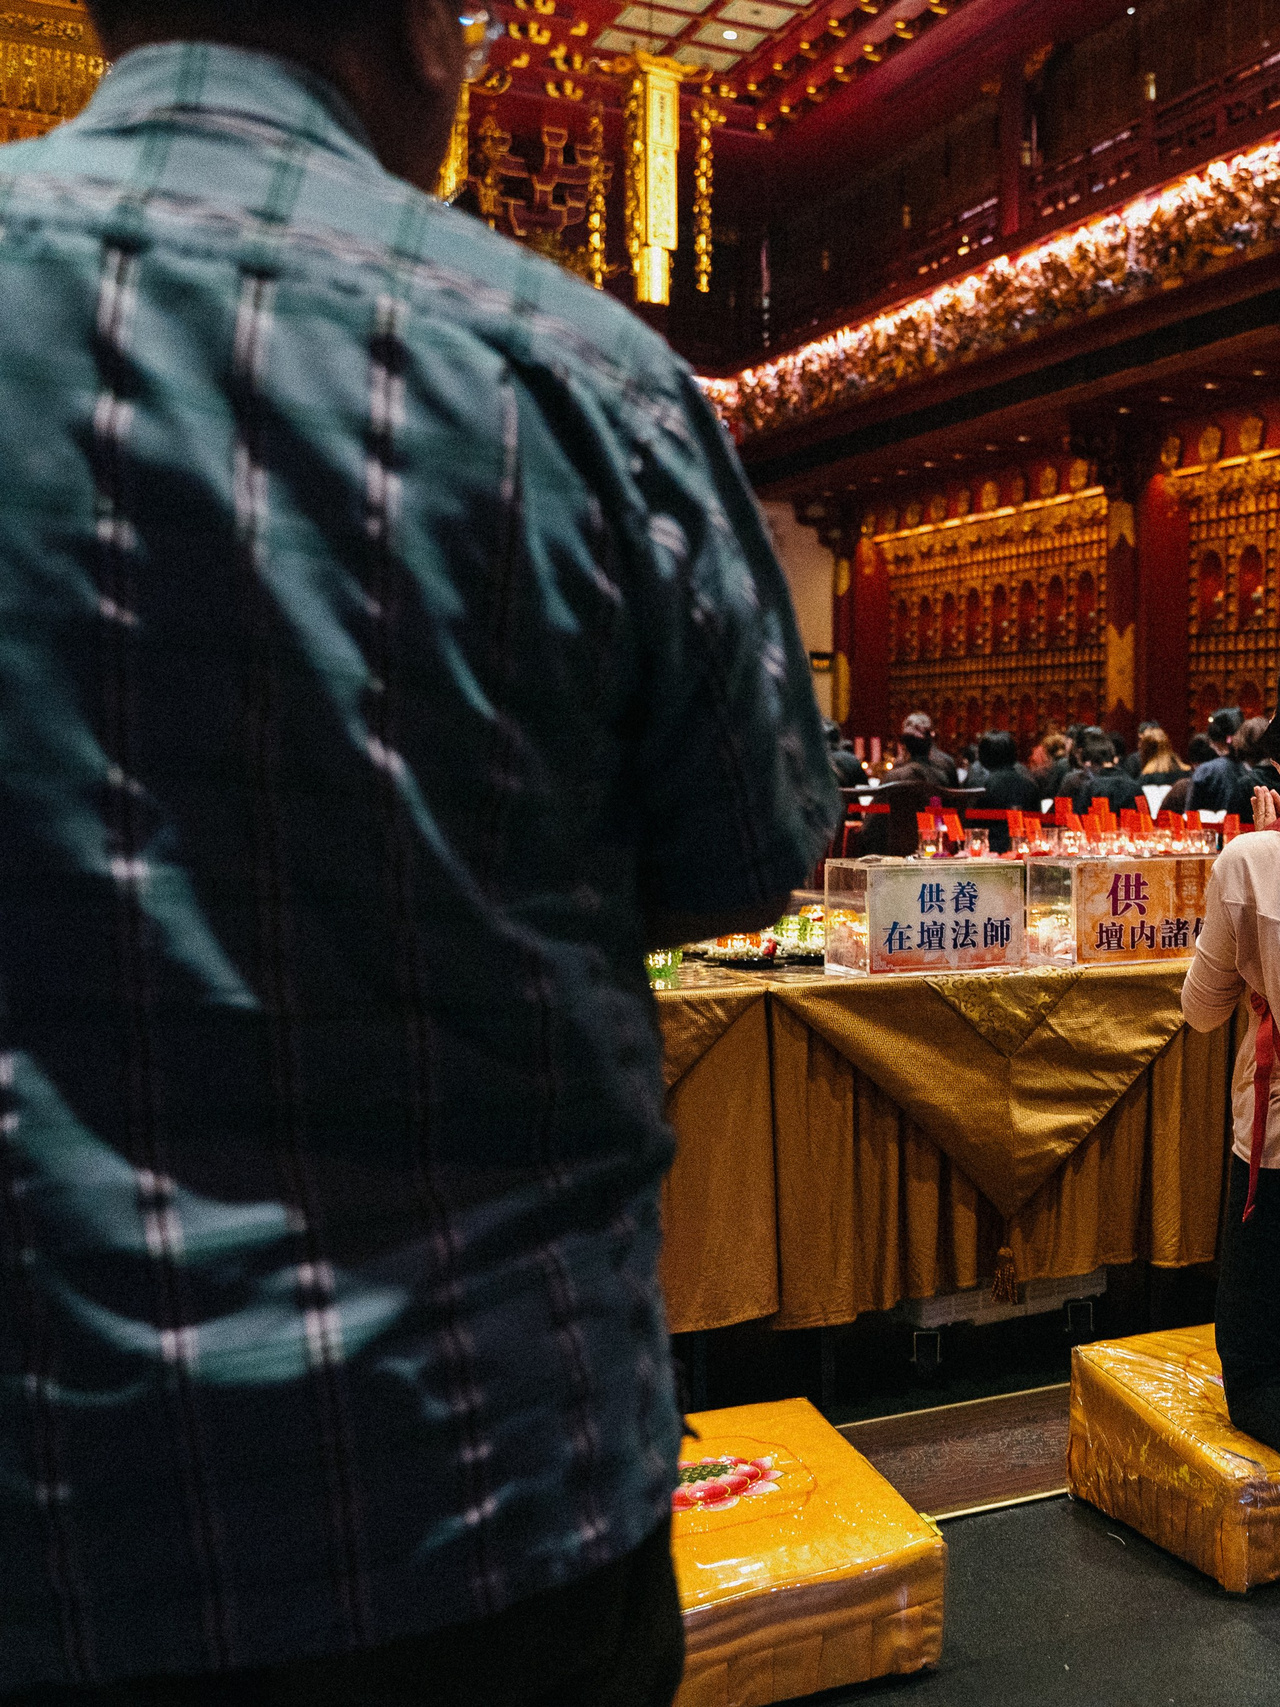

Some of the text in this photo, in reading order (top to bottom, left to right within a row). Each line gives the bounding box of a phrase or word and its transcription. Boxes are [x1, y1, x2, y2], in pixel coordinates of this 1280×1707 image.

[917, 881, 978, 913] 供養
[1106, 873, 1149, 916] 供
[882, 917, 1011, 954] 在壇法師
